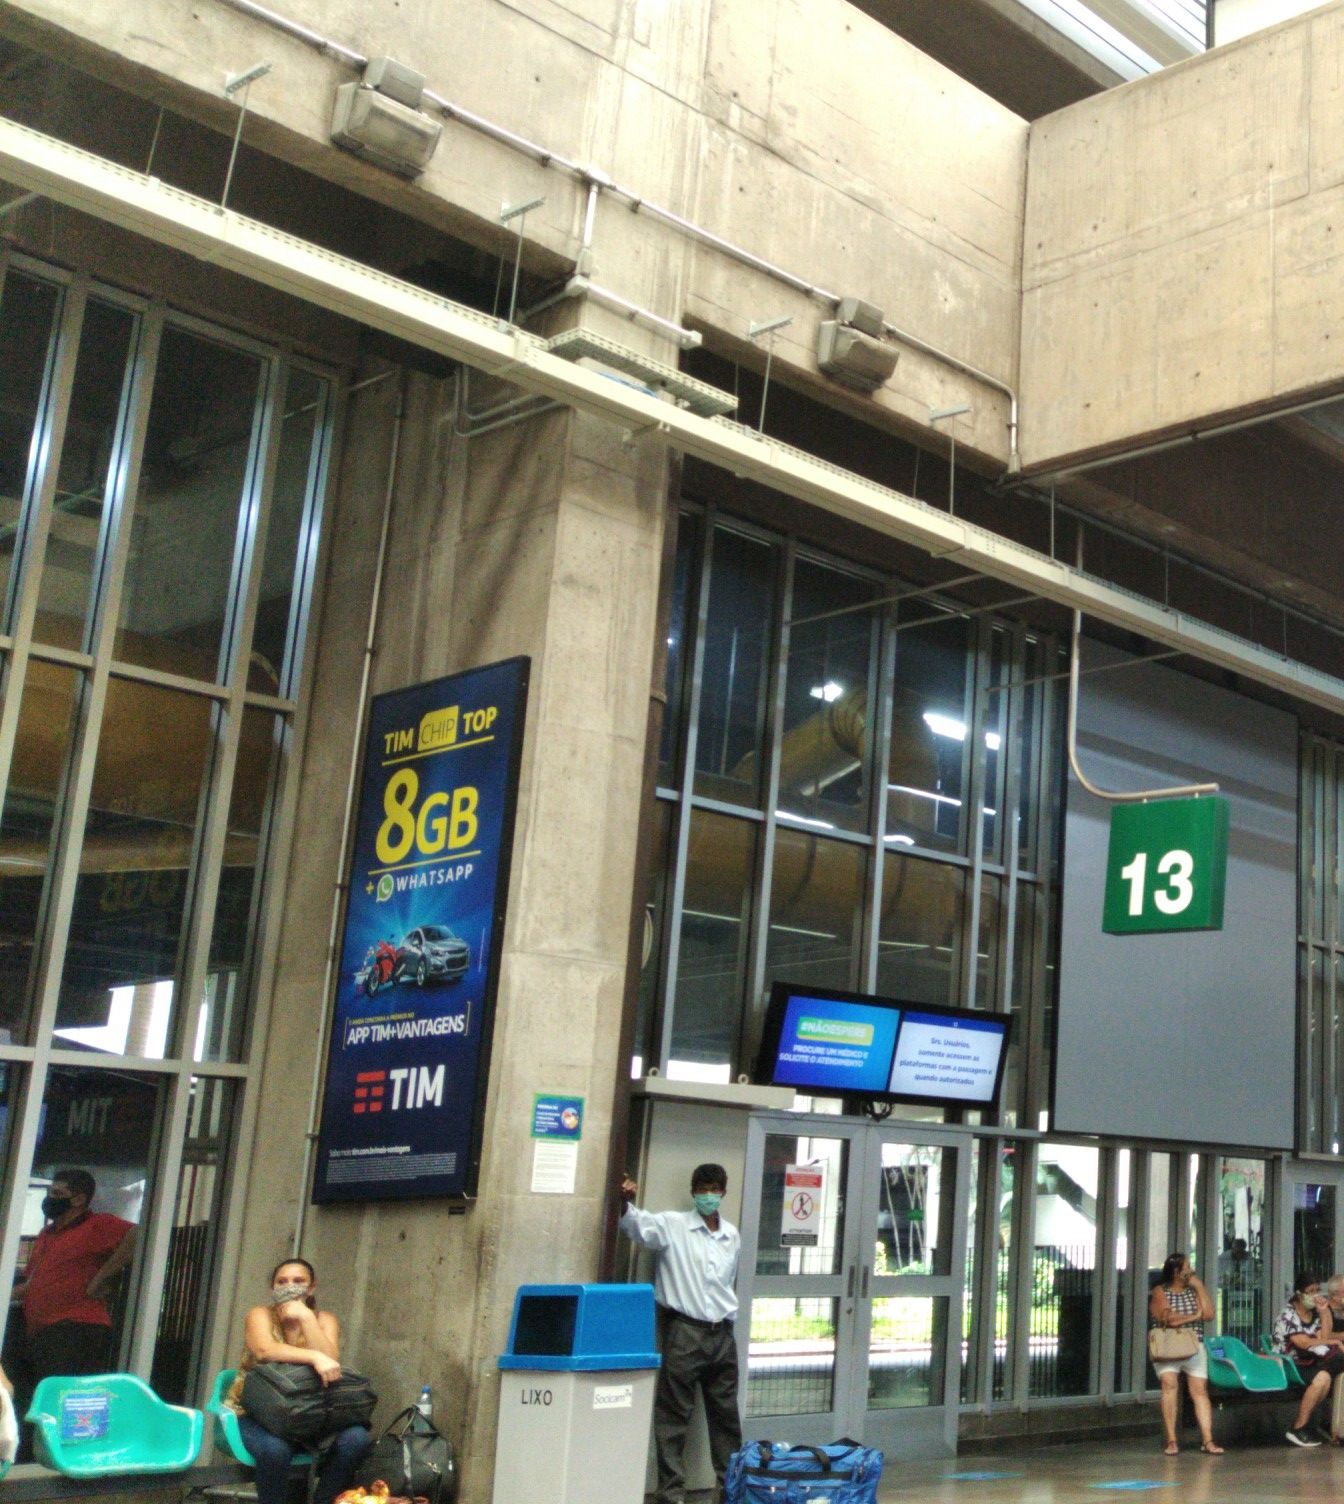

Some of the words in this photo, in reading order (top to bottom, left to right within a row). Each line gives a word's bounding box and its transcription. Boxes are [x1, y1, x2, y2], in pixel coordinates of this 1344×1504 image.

[384, 728, 414, 754] TIM
[421, 718, 455, 744] CHIP
[463, 706, 498, 734] TOP
[375, 767, 479, 865] 8GB
[396, 864, 473, 892] WHATSAPP
[1121, 849, 1194, 916] 13
[347, 1025, 370, 1045] APP
[370, 1014, 465, 1043] TIM+VANTAGENS
[389, 1063, 445, 1111] TIM
[521, 1389, 553, 1406] LIXO
